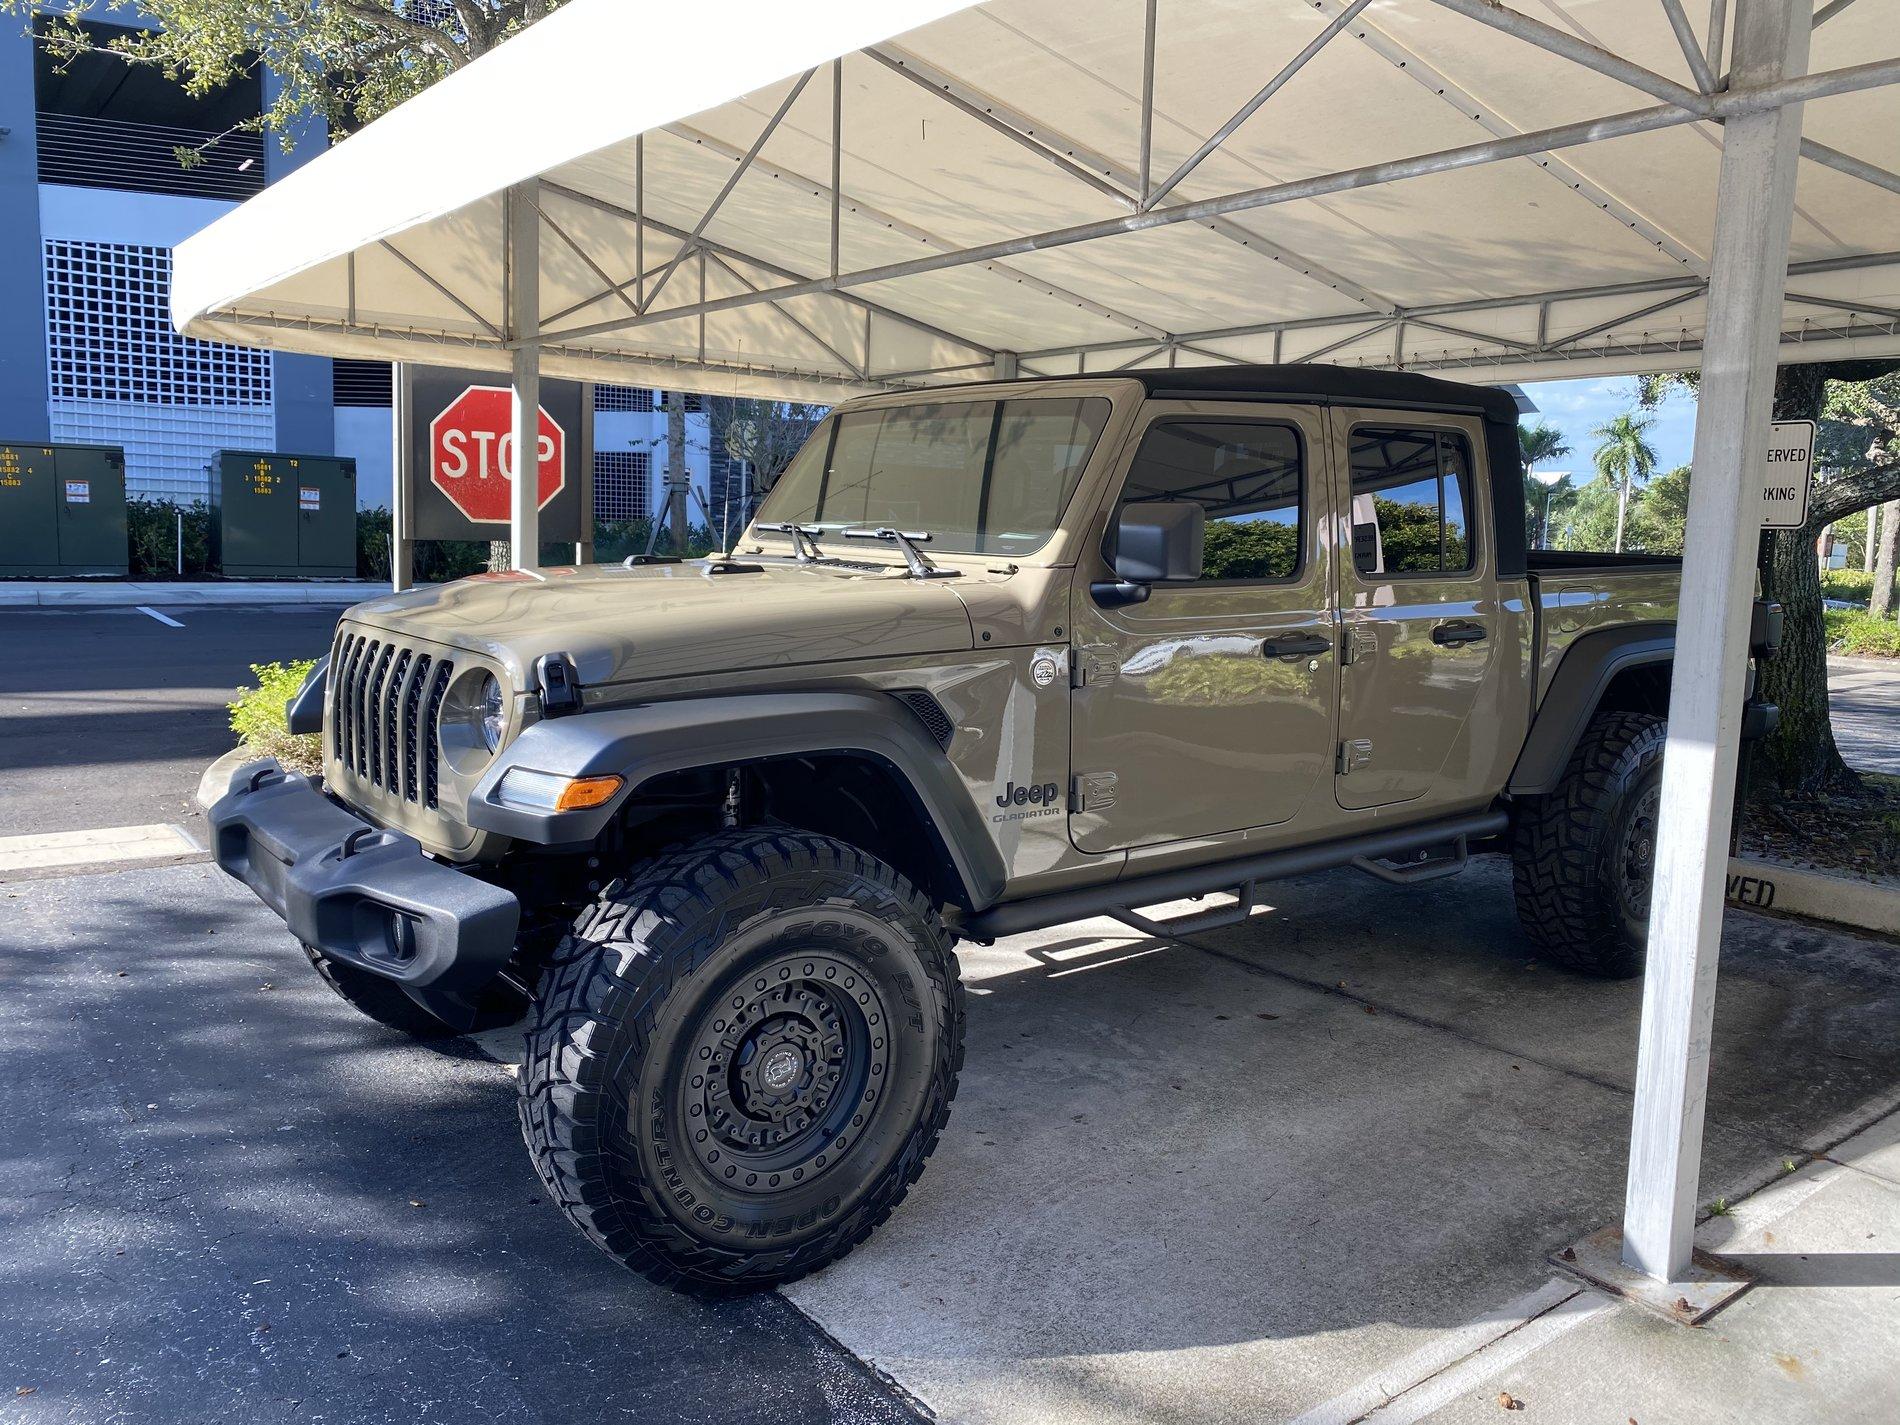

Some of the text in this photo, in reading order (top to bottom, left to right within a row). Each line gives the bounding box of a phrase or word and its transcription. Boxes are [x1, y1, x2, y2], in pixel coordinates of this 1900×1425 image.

[441, 428, 555, 481] STOP
[1767, 448, 1806, 462] ERVED
[1763, 487, 1796, 501] KING
[996, 781, 1059, 808] Jeep
[992, 807, 1061, 823] GLADIATOR
[782, 920, 890, 956] TOYO
[650, 1087, 843, 1239] OPEN COUNTRY
